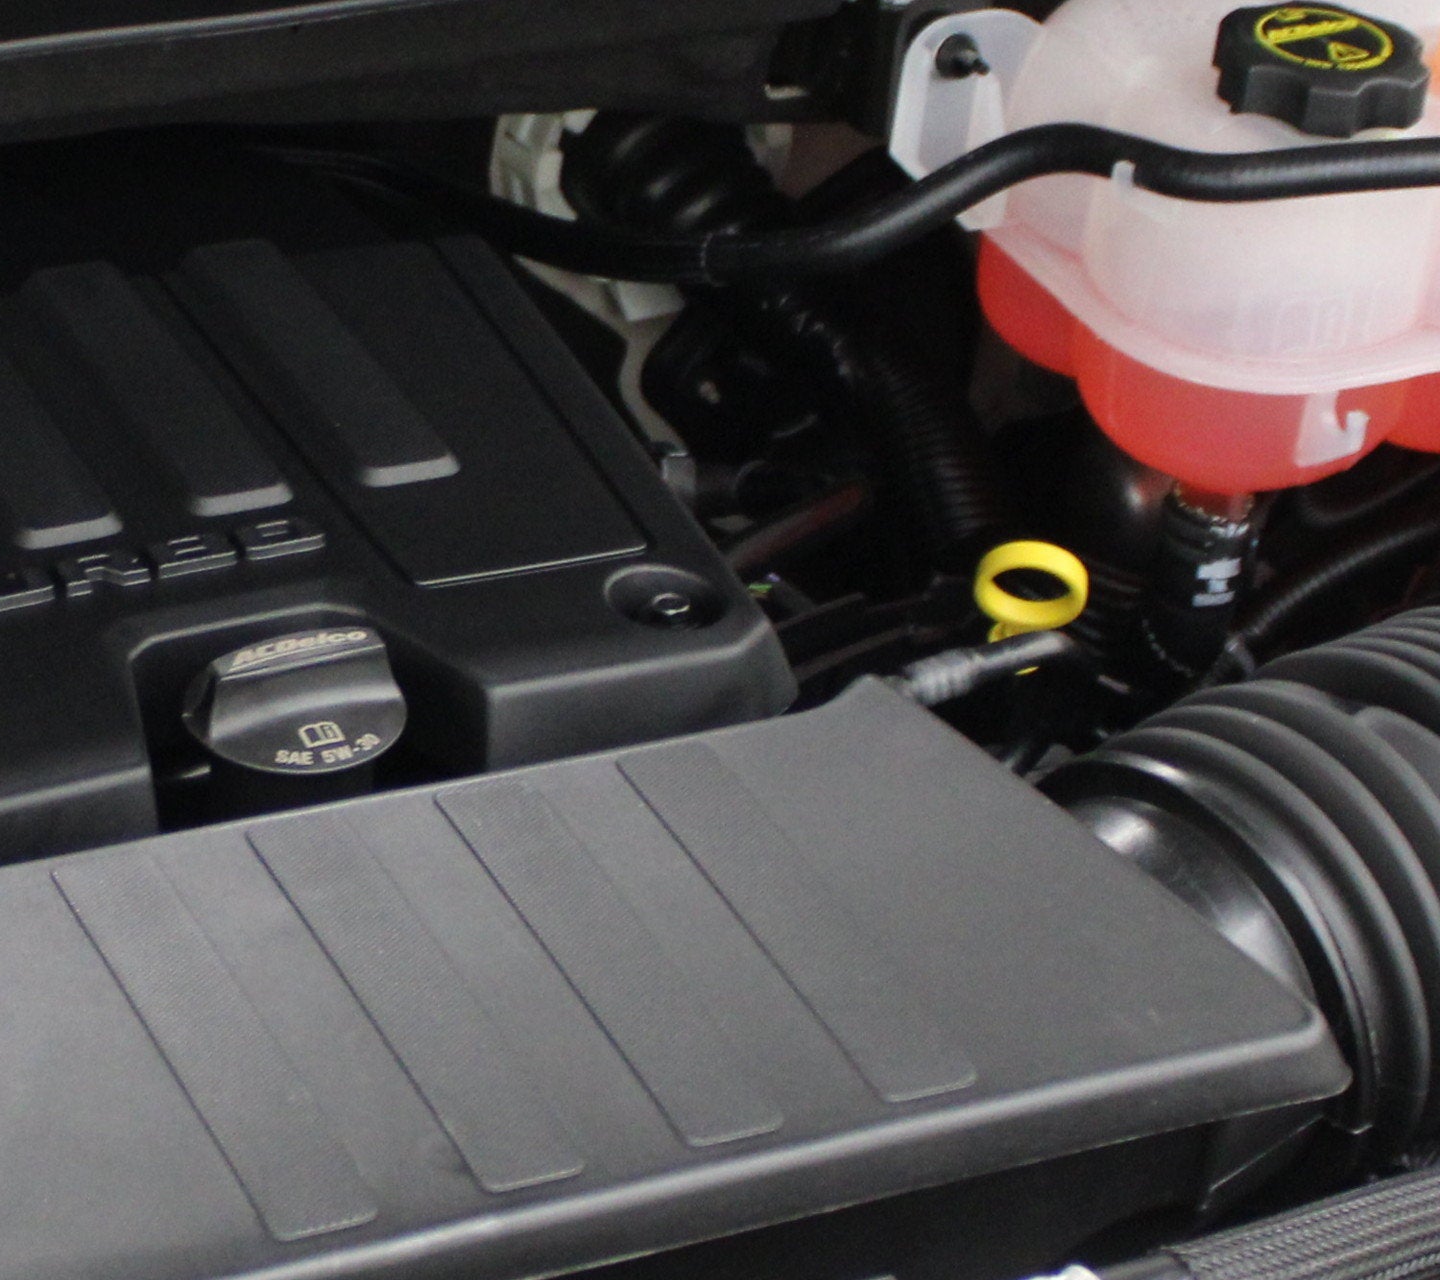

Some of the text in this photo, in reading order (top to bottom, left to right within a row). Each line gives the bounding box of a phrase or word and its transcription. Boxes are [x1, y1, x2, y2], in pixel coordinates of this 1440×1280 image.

[231, 630, 368, 666] ACDelco
[274, 733, 380, 765] SAE 5W-30
